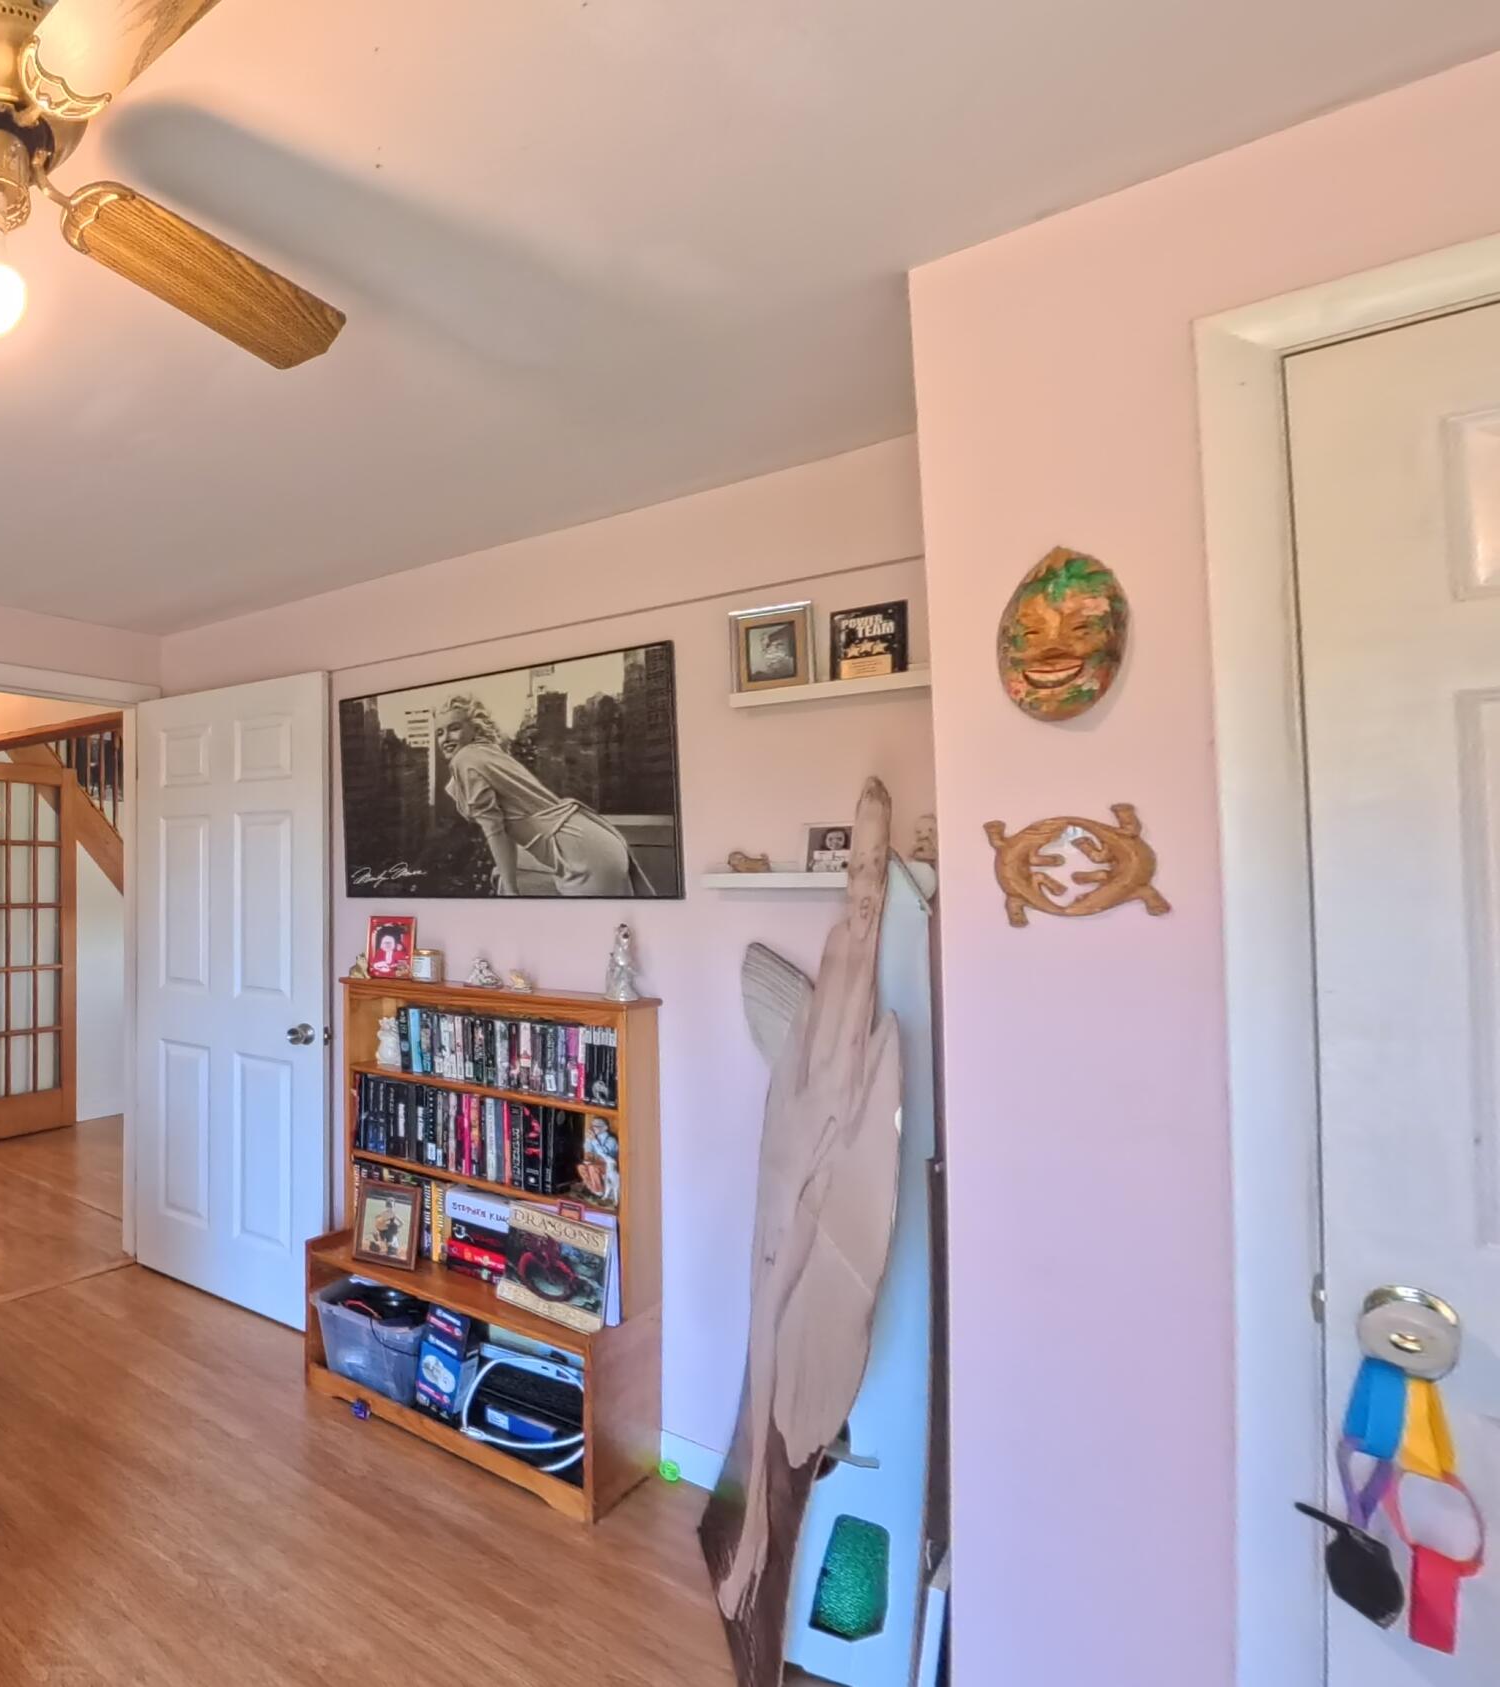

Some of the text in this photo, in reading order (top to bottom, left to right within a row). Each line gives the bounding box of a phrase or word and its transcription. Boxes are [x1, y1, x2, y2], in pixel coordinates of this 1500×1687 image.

[841, 614, 883, 630] POWER
[857, 621, 895, 638] TEAM
[451, 1201, 487, 1218] STEPHEN
[512, 1208, 605, 1248] DRAGONS
